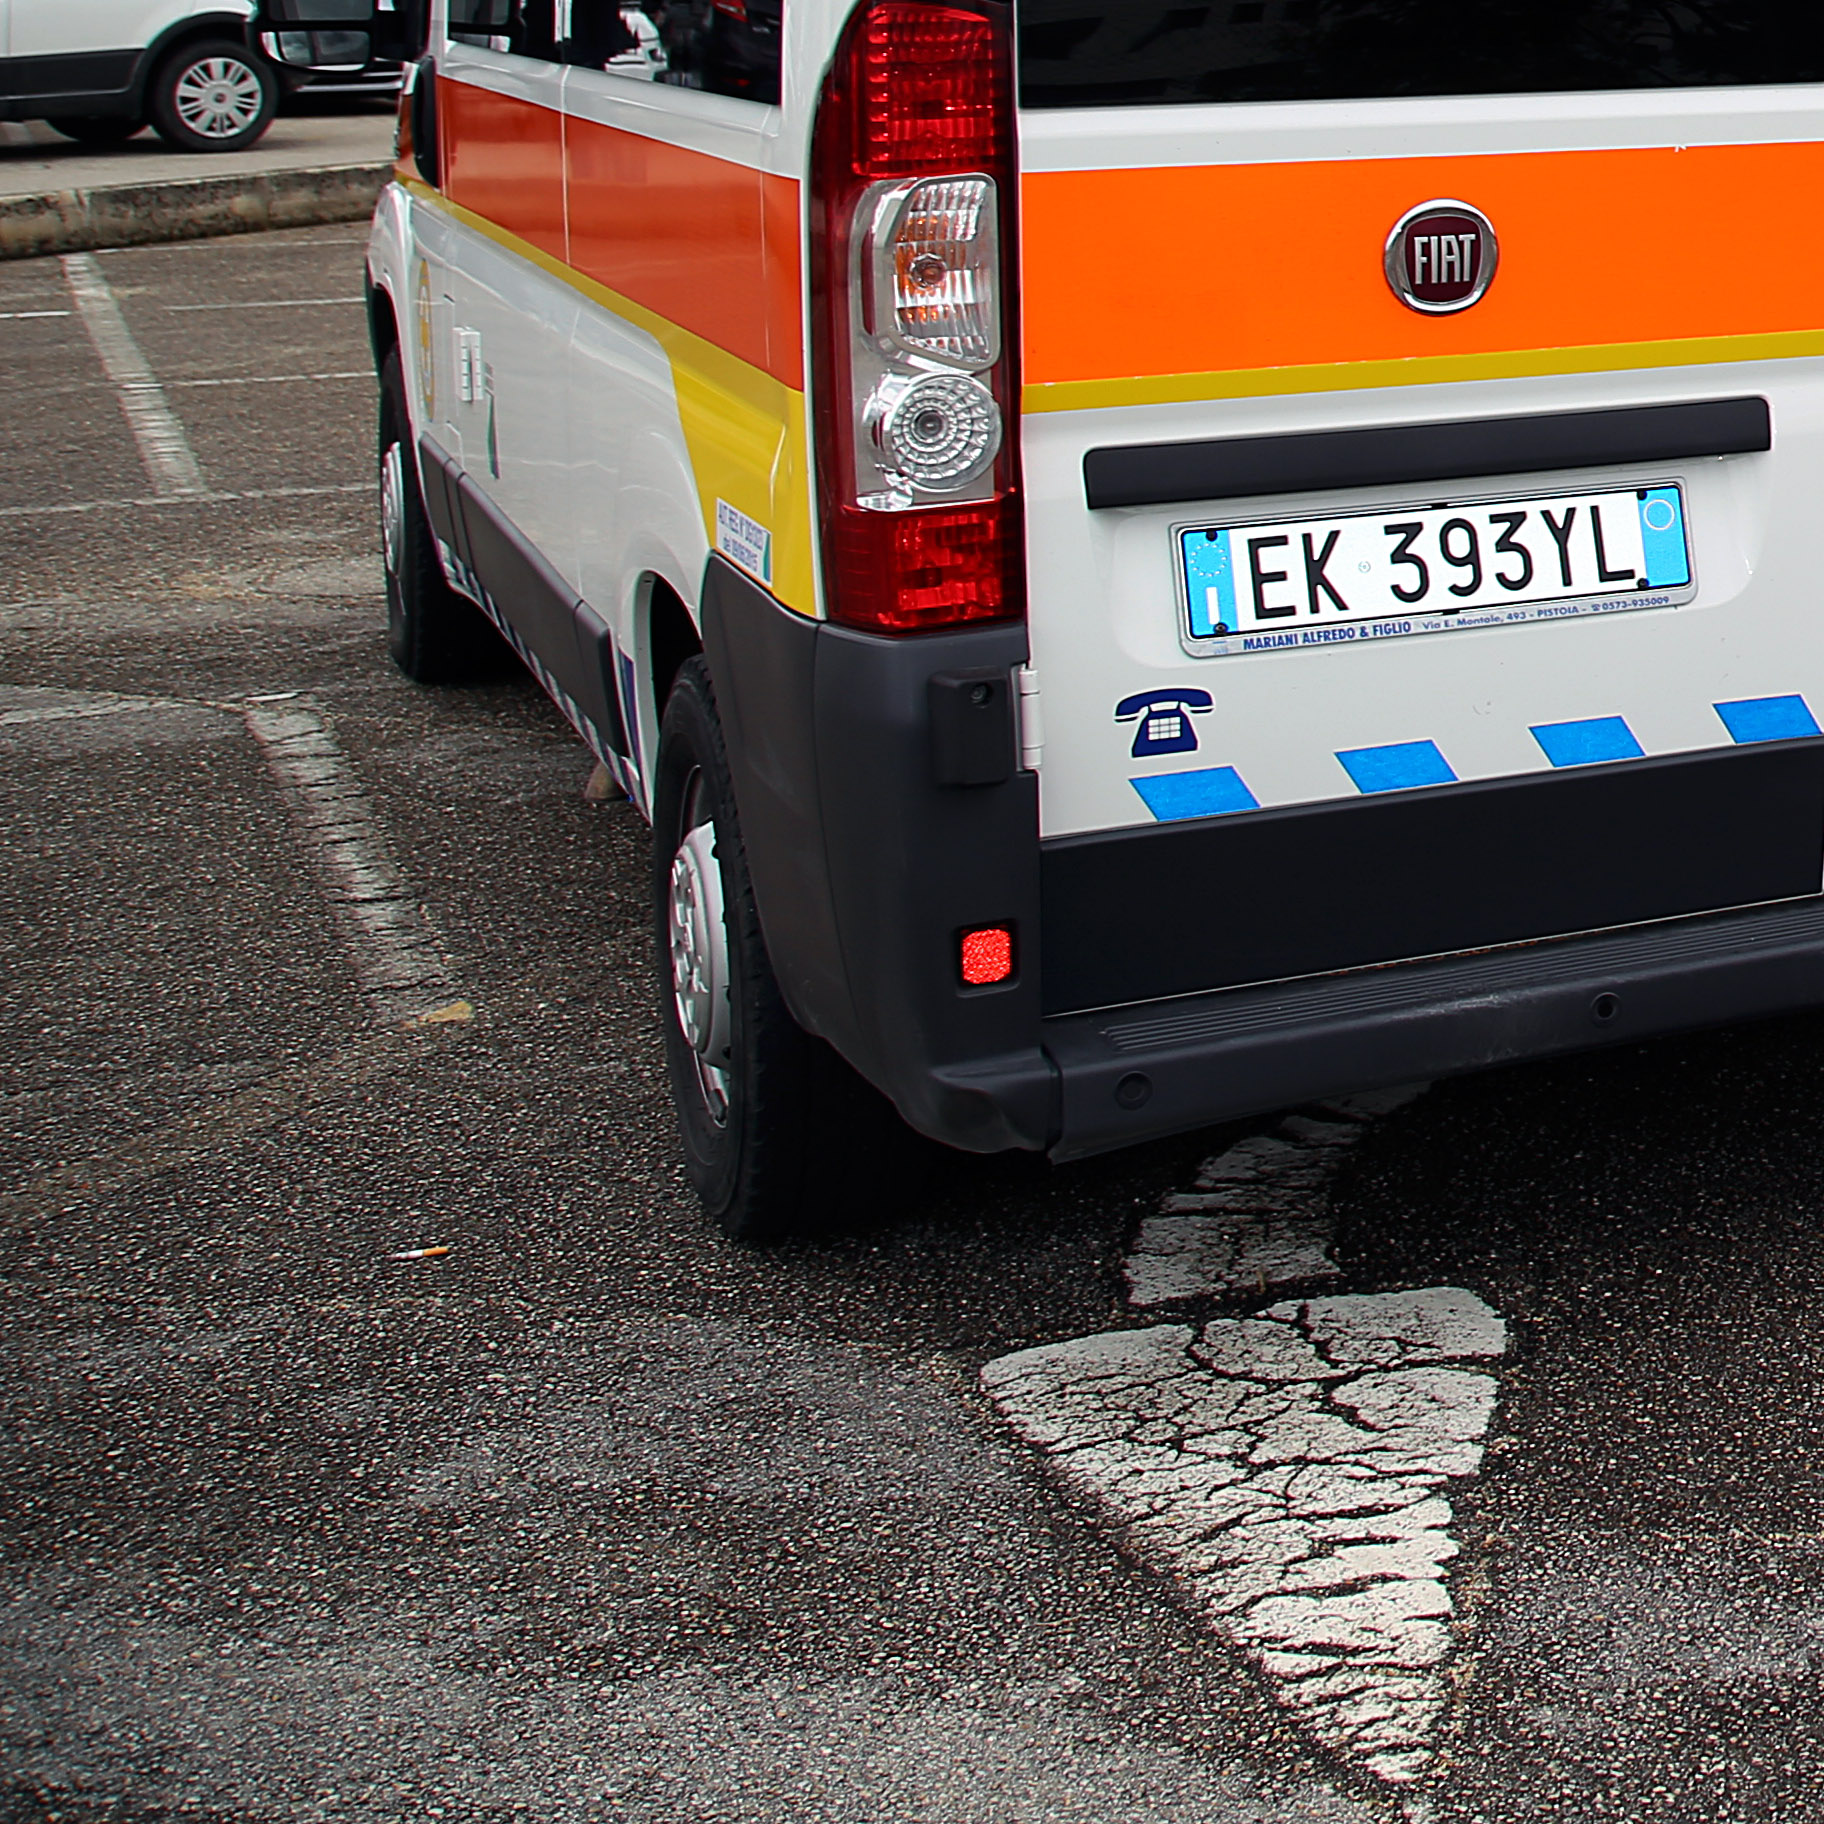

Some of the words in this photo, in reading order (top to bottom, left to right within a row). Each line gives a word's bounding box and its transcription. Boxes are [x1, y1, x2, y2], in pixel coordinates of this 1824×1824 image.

[1413, 232, 1479, 287] FIAT
[1246, 529, 1349, 621] EK
[1383, 505, 1637, 604] 393YL
[1243, 632, 1299, 651] MARIANI
[1302, 626, 1356, 644] ALFREDO
[1359, 625, 1369, 638] &
[1372, 620, 1412, 637] FIGLIO
[1423, 619, 1440, 630] Via
[1444, 617, 1455, 628] E.
[1506, 611, 1526, 621] 493
[1537, 605, 1580, 618] PISTOIA
[1602, 596, 1670, 610] 0573-935009
